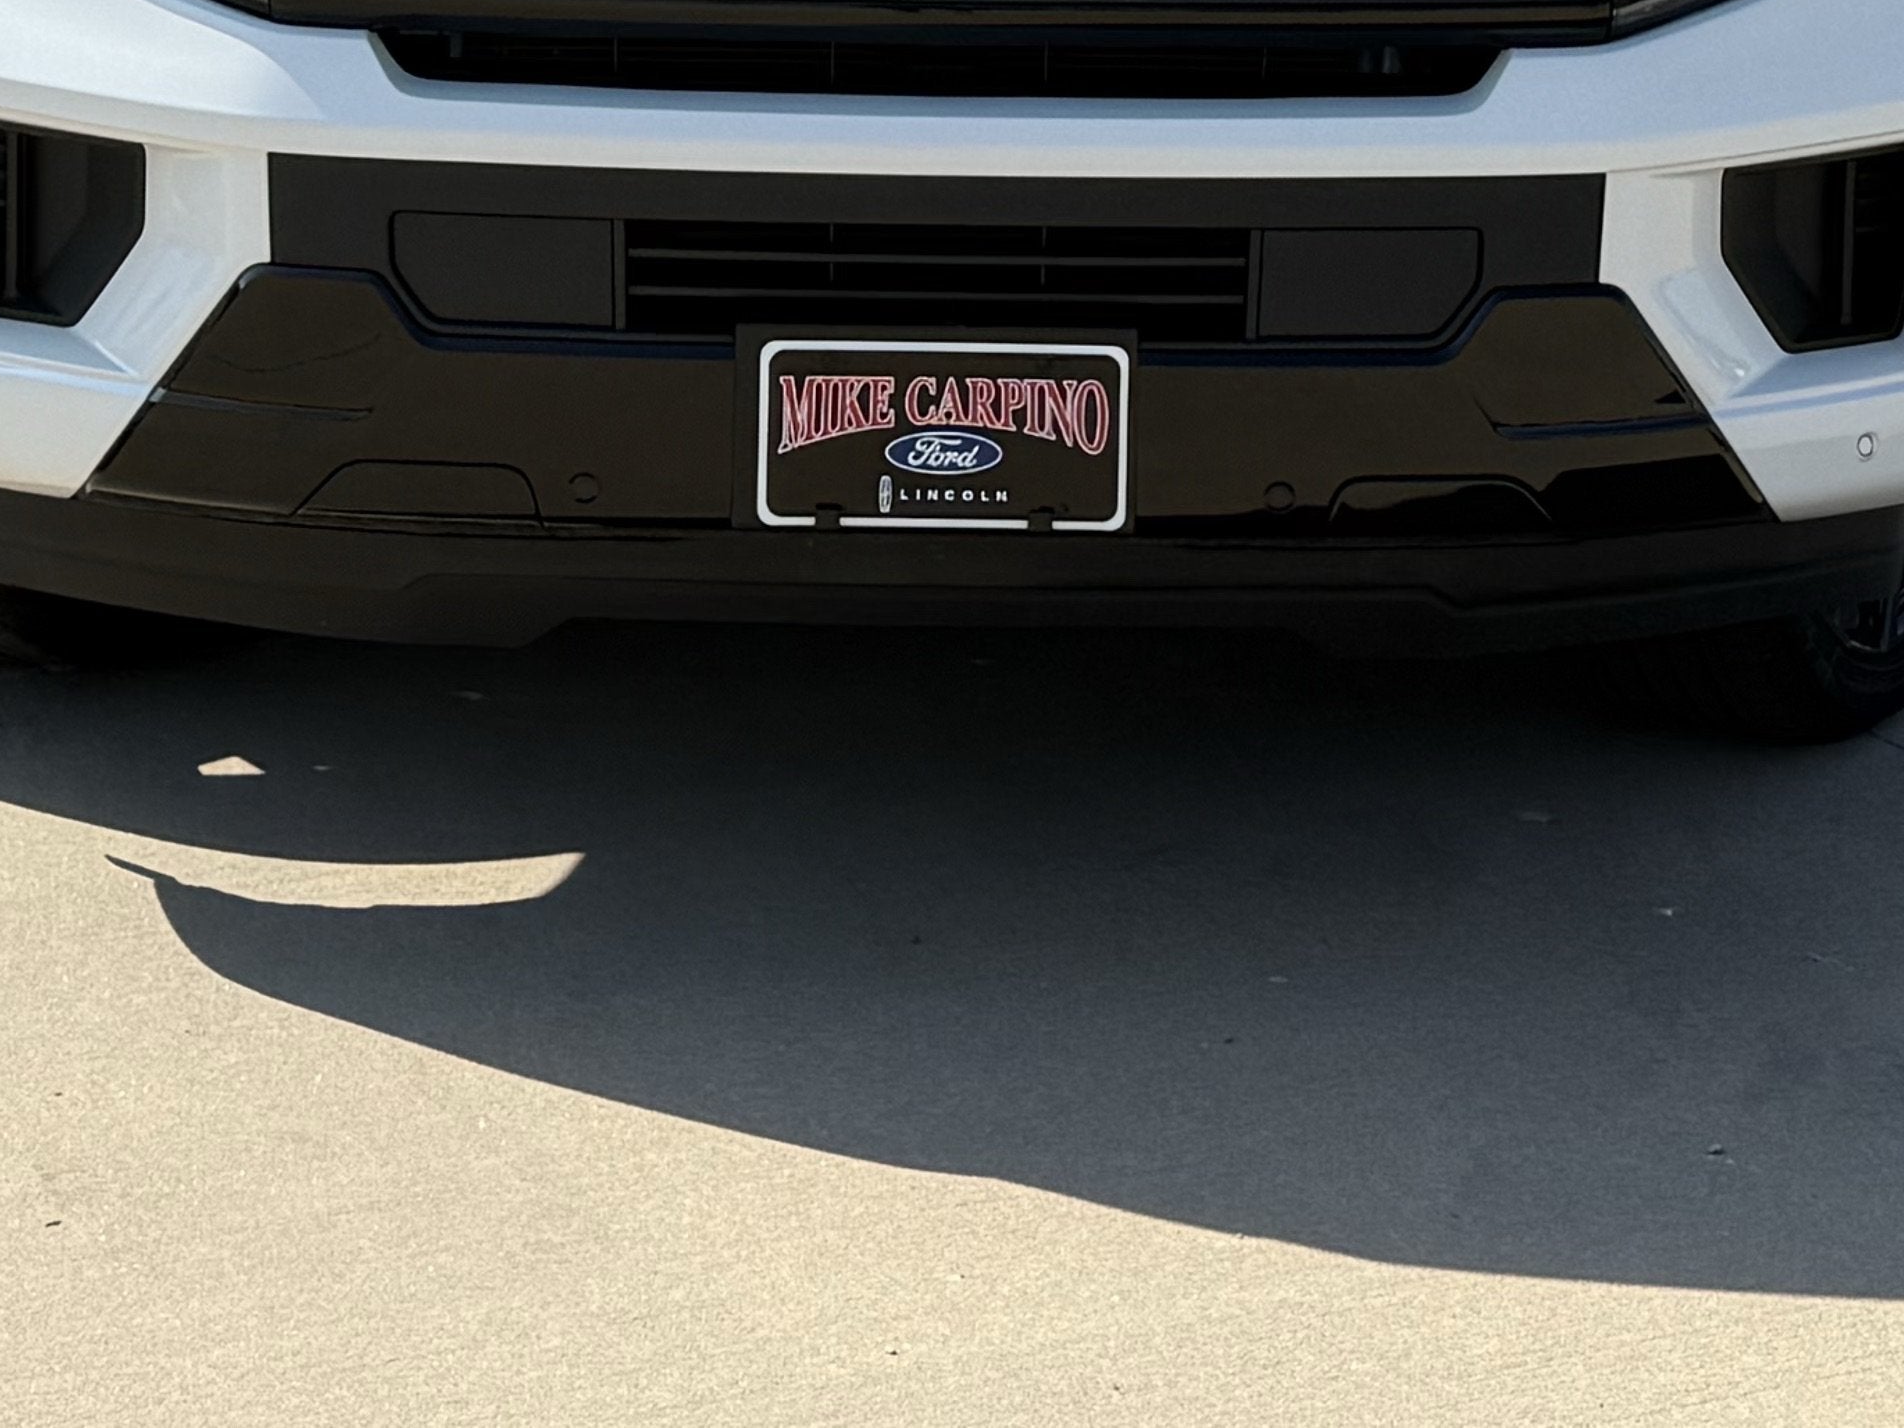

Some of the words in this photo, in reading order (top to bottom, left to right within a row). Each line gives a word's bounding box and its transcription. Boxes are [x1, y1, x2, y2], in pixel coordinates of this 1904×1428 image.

[777, 375, 895, 455] MIKE
[904, 376, 1110, 456] CARPINO
[907, 437, 978, 469] Ford
[899, 487, 1009, 503] LINCOLN
